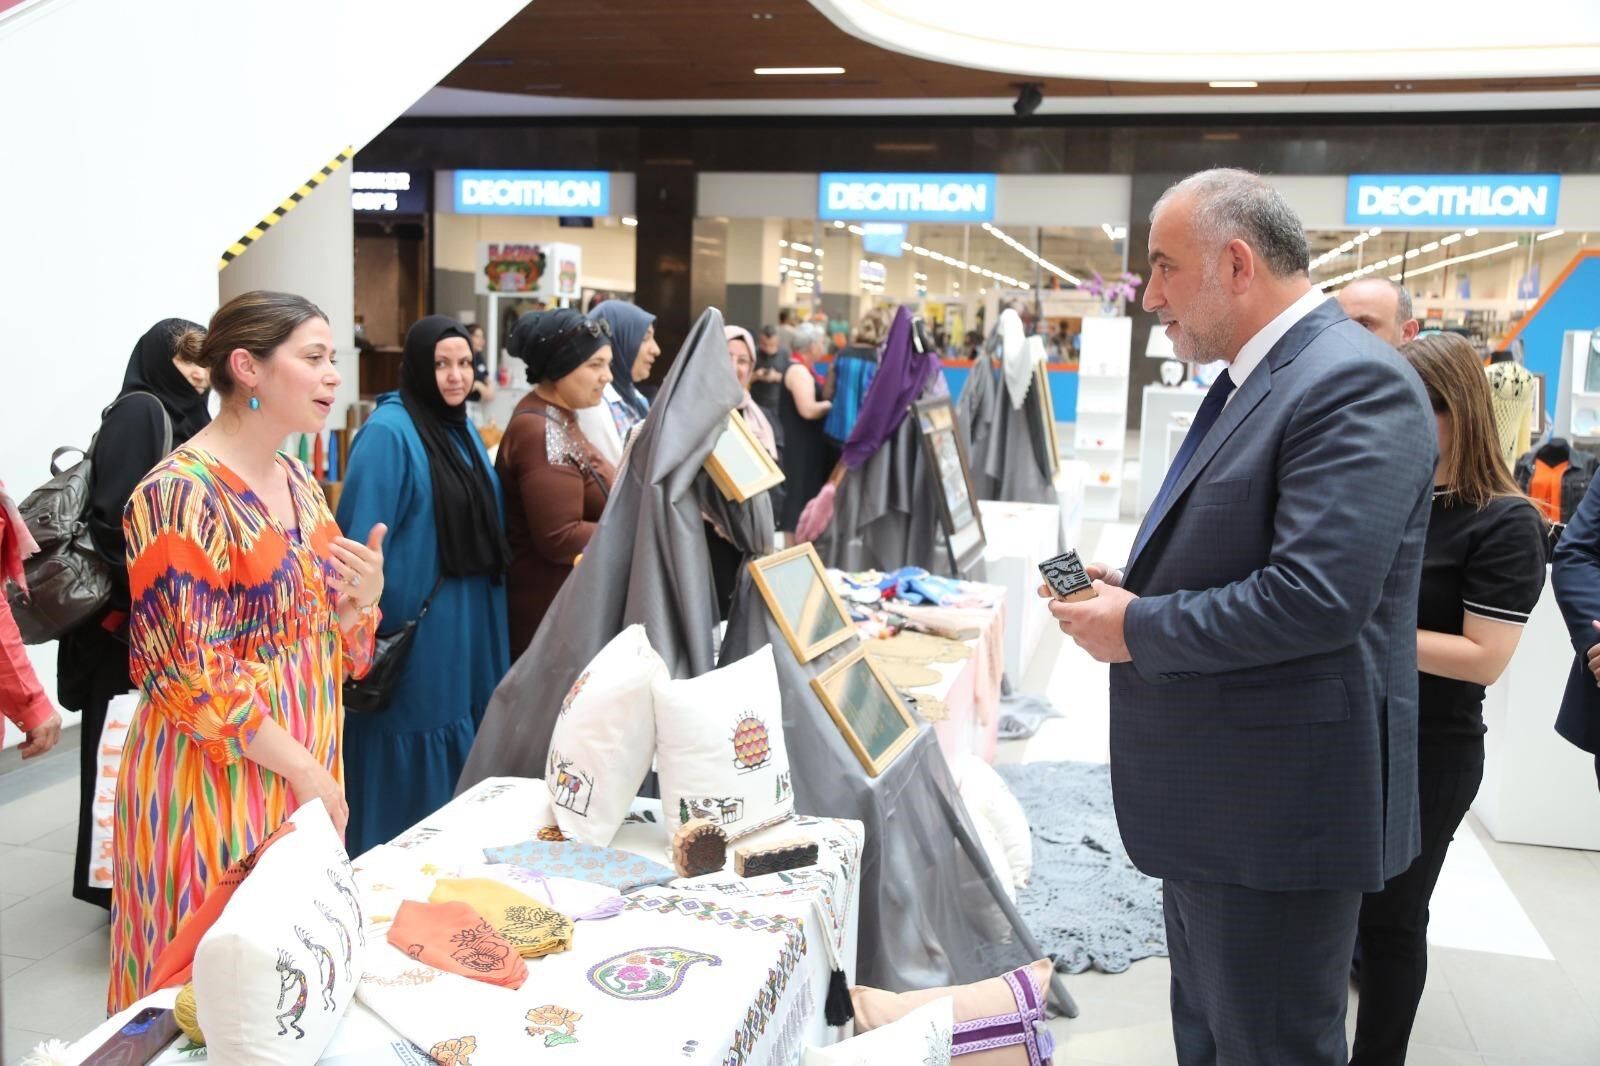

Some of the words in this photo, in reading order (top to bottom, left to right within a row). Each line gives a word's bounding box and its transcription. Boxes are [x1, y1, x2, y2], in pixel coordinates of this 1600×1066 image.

[462, 179, 600, 206] DECATHLON
[828, 182, 986, 211] DECATHLON
[1358, 185, 1547, 215] DECATHLON
